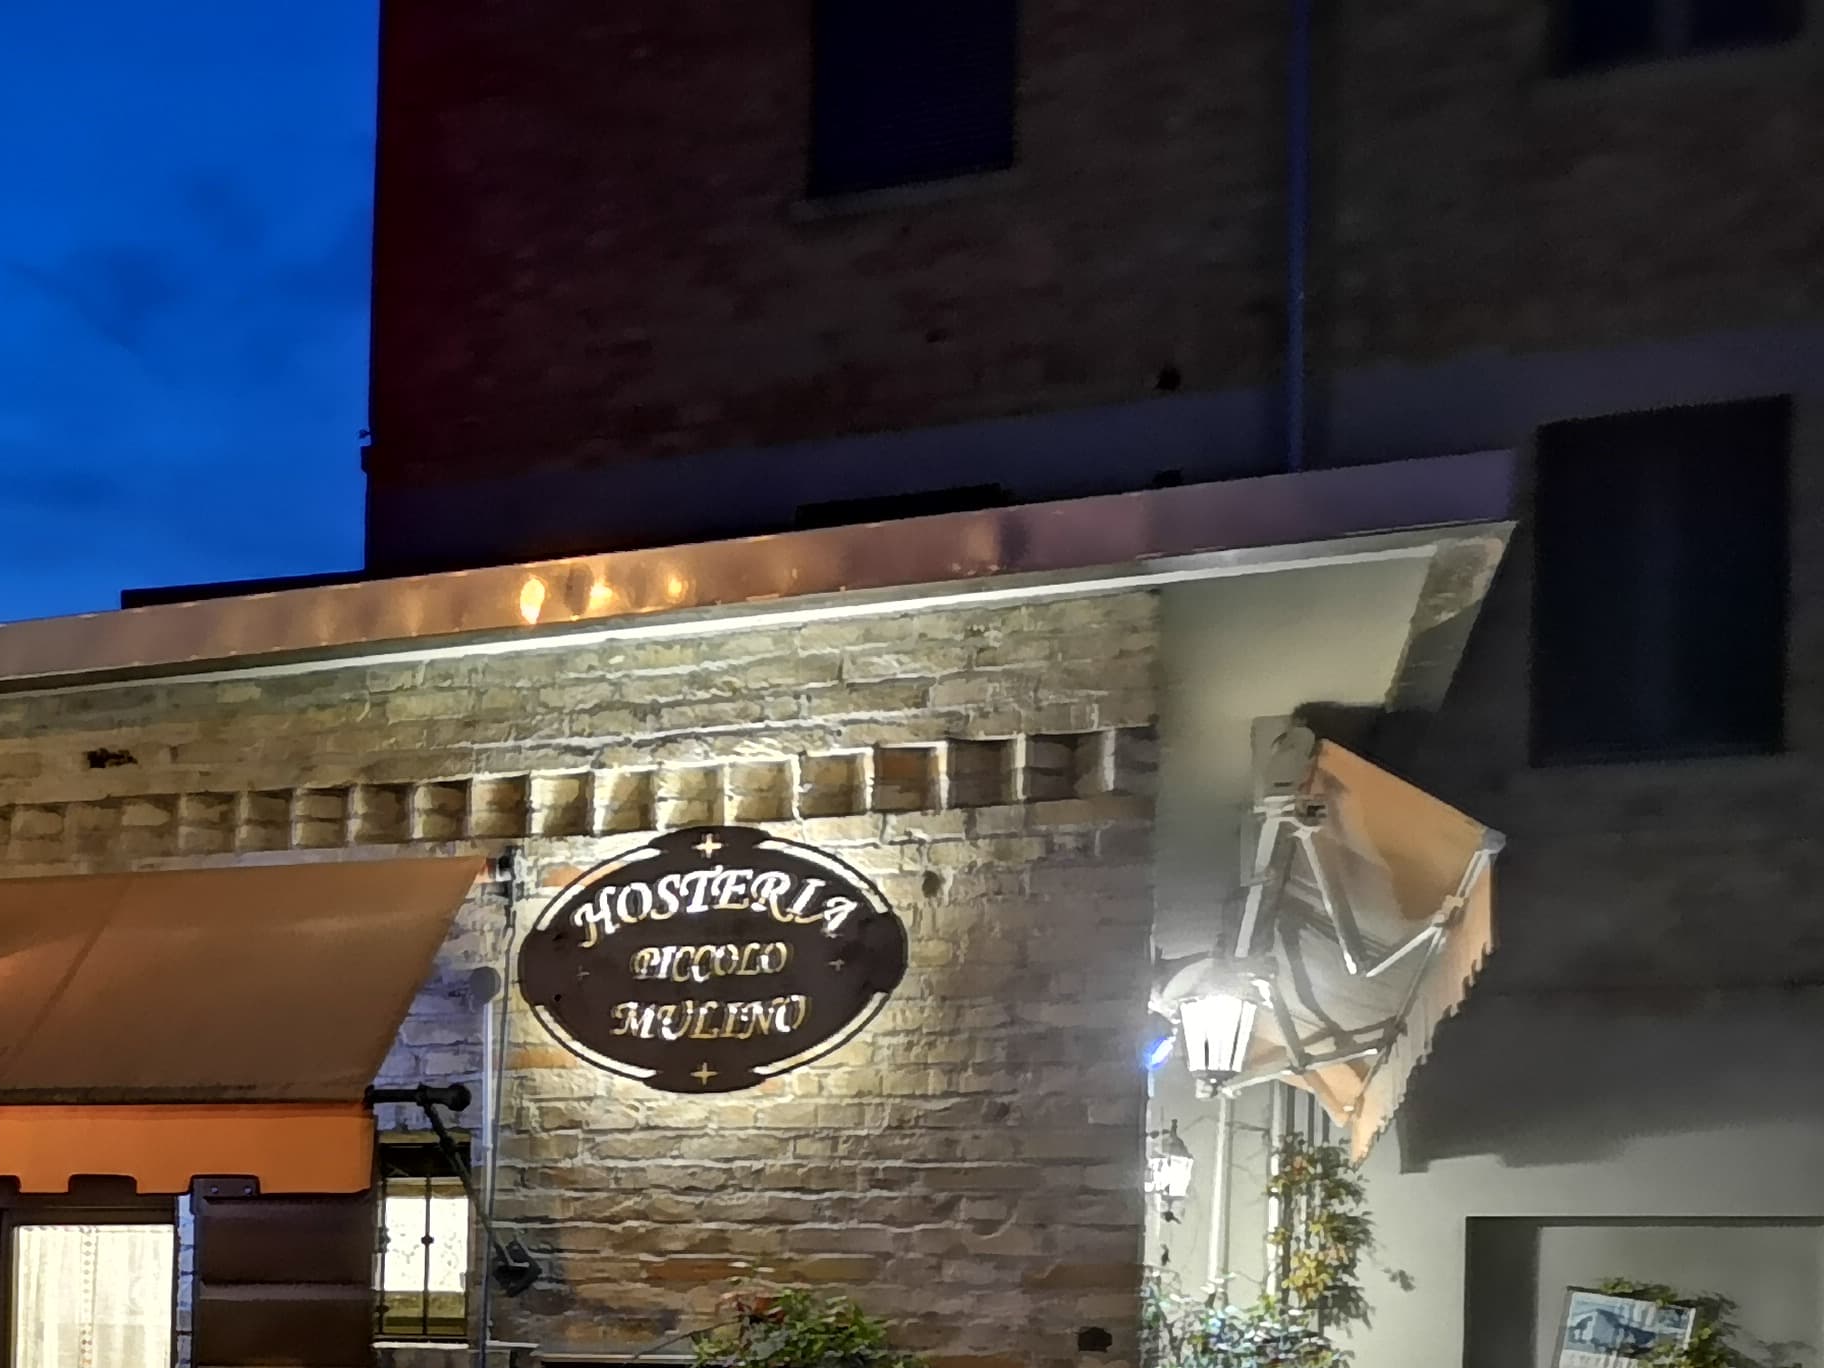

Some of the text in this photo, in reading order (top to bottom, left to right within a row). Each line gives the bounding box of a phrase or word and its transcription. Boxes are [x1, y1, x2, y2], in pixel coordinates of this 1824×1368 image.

[574, 864, 859, 948] HOSTERIA
[632, 942, 789, 983] PICCOLO
[609, 995, 808, 1041] MULINO
